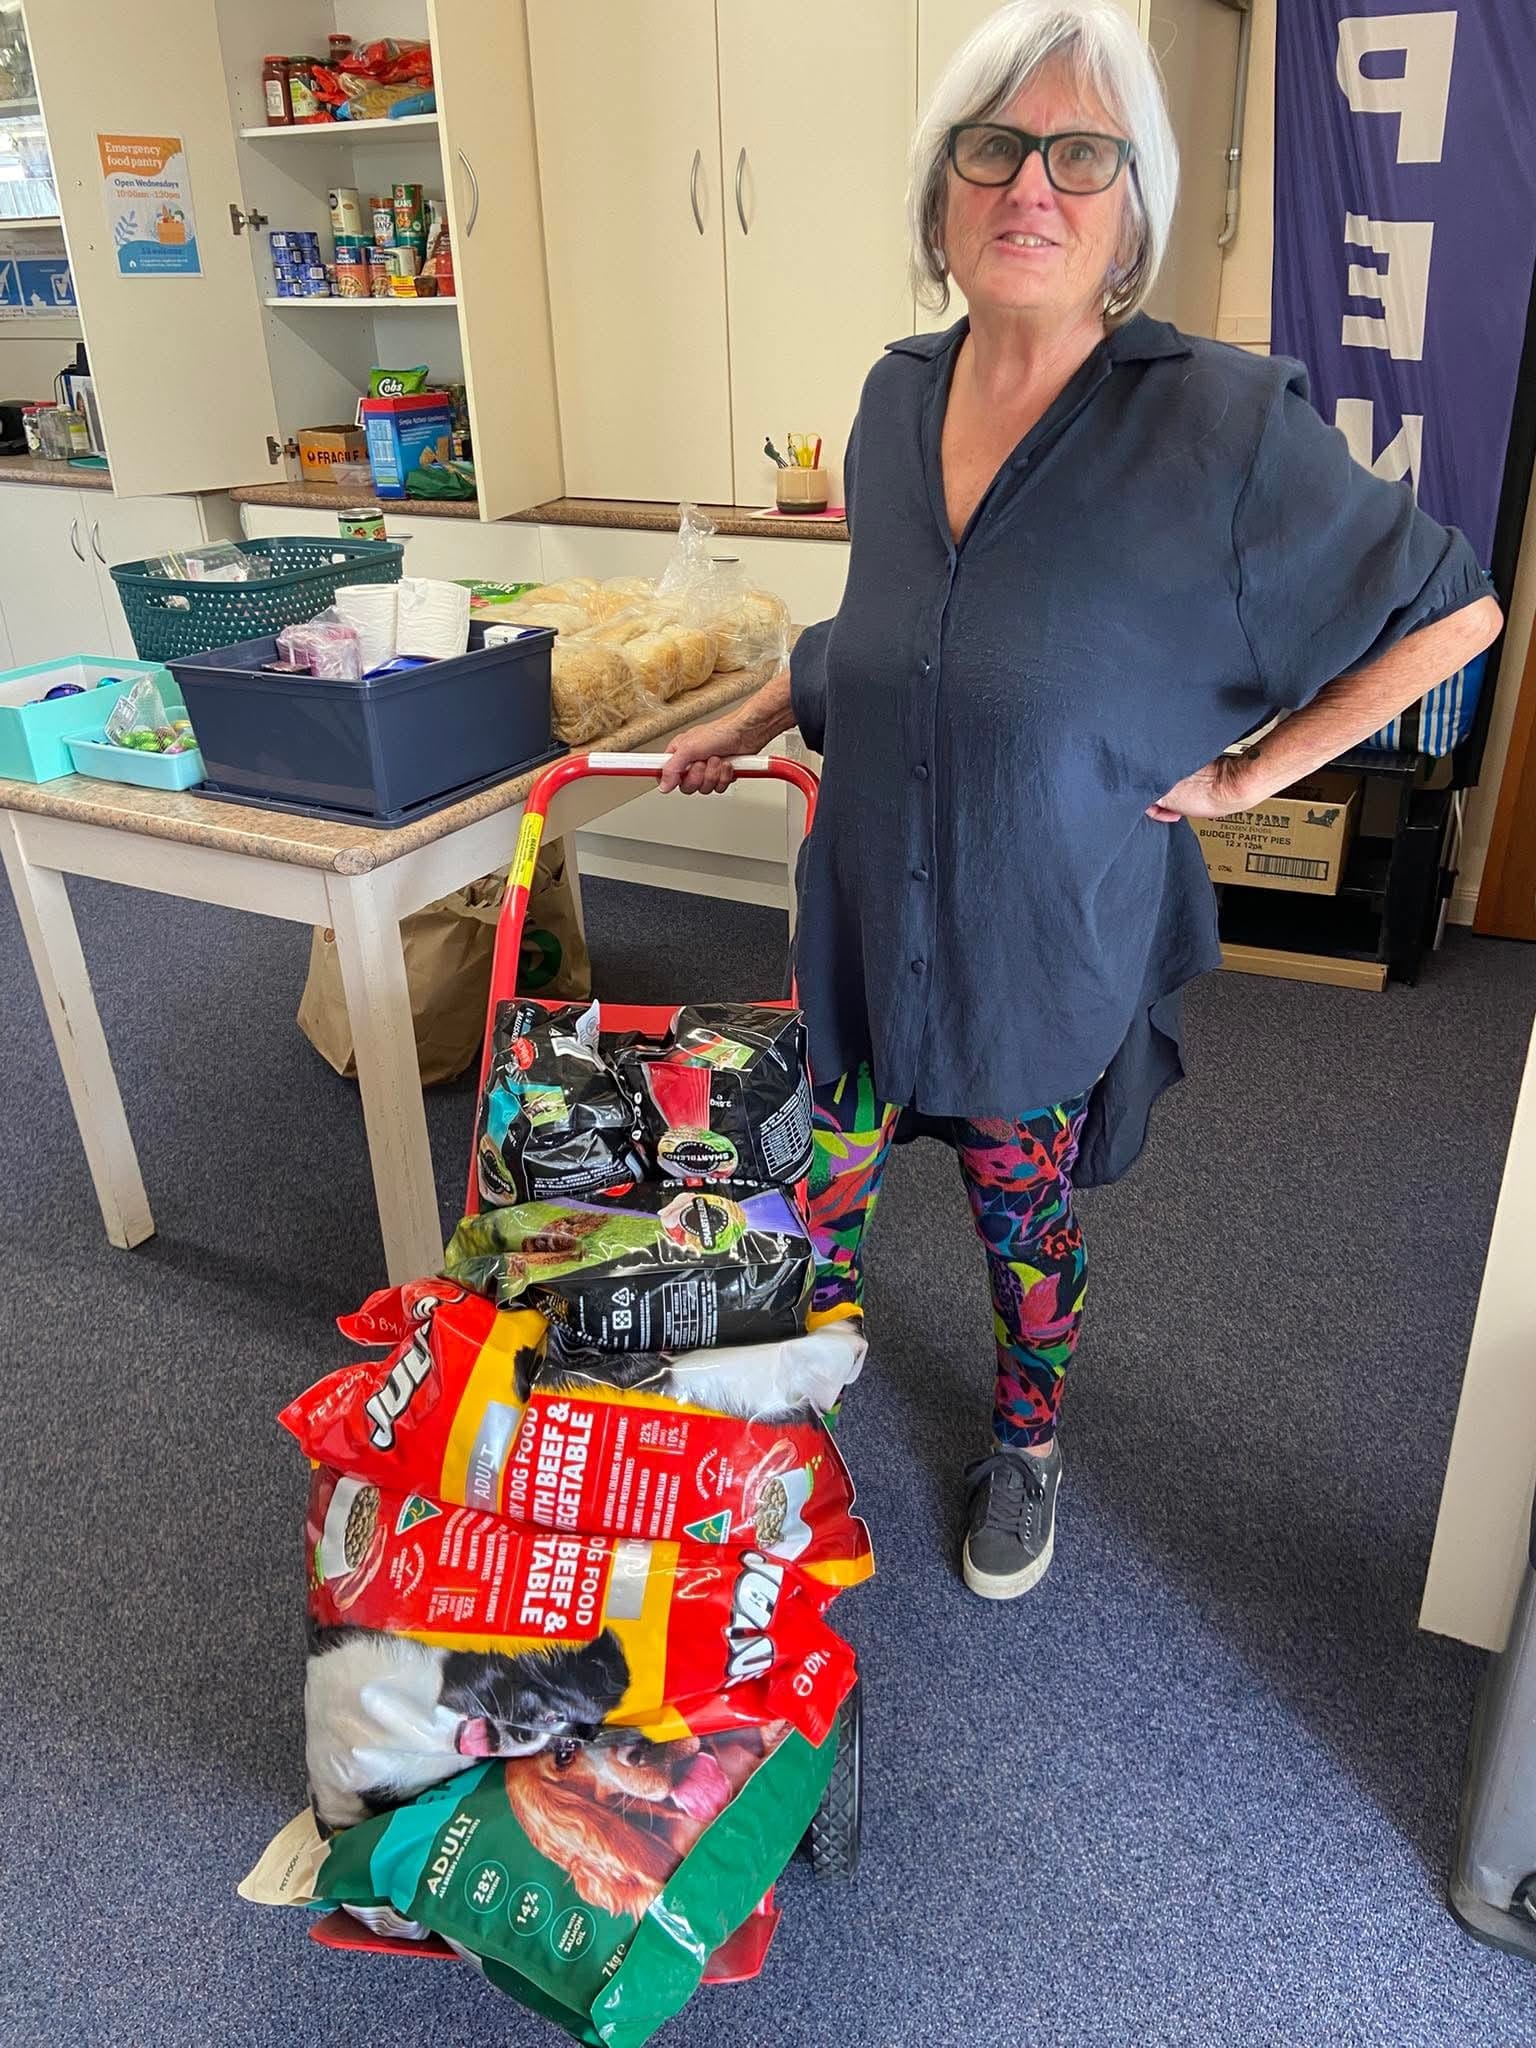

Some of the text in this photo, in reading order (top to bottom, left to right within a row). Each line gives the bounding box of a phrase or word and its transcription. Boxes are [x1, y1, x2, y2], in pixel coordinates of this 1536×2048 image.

[105, 142, 160, 155] Emergency
[107, 155, 162, 168] food pantry
[114, 178, 179, 188] Open Wednesdays
[378, 378, 402, 396] Cobs
[1208, 812, 1291, 829] AMILY FARM
[1200, 829, 1291, 846] BUDGET PARTY PIES
[1225, 839, 1234, 847] 12
[546, 1401, 571, 1423] &
[514, 1407, 539, 1465] FOOD
[640, 1422, 651, 1443] 22%
[667, 1426, 678, 1447] 10%
[535, 1423, 565, 1488] BEEF
[474, 1443, 494, 1500] ADULT
[716, 1456, 727, 1495] COMPLETE
[509, 1467, 529, 1501] DOG
[543, 1542, 581, 1635] BEEF &
[575, 1566, 601, 1626] FOOD
[436, 1593, 447, 1616] 10%
[462, 1596, 474, 1619] 22%
[427, 1813, 472, 1896] ADULT
[437, 1886, 446, 1898] ALL
[442, 1860, 458, 1885] BREEDS
[454, 1845, 464, 1861] AND
[462, 1834, 470, 1845] ALL
[473, 1868, 497, 1904] 28%
[485, 1875, 501, 1904] PROTEIN
[516, 1891, 539, 1925] 14%
[531, 1905, 540, 1919] FAT
[557, 1929, 570, 1948] MADE
[562, 1916, 585, 1952] SALMON
[574, 1929, 586, 1945] OIL
[602, 1967, 613, 1977] 7
[606, 1954, 622, 1971] kg
